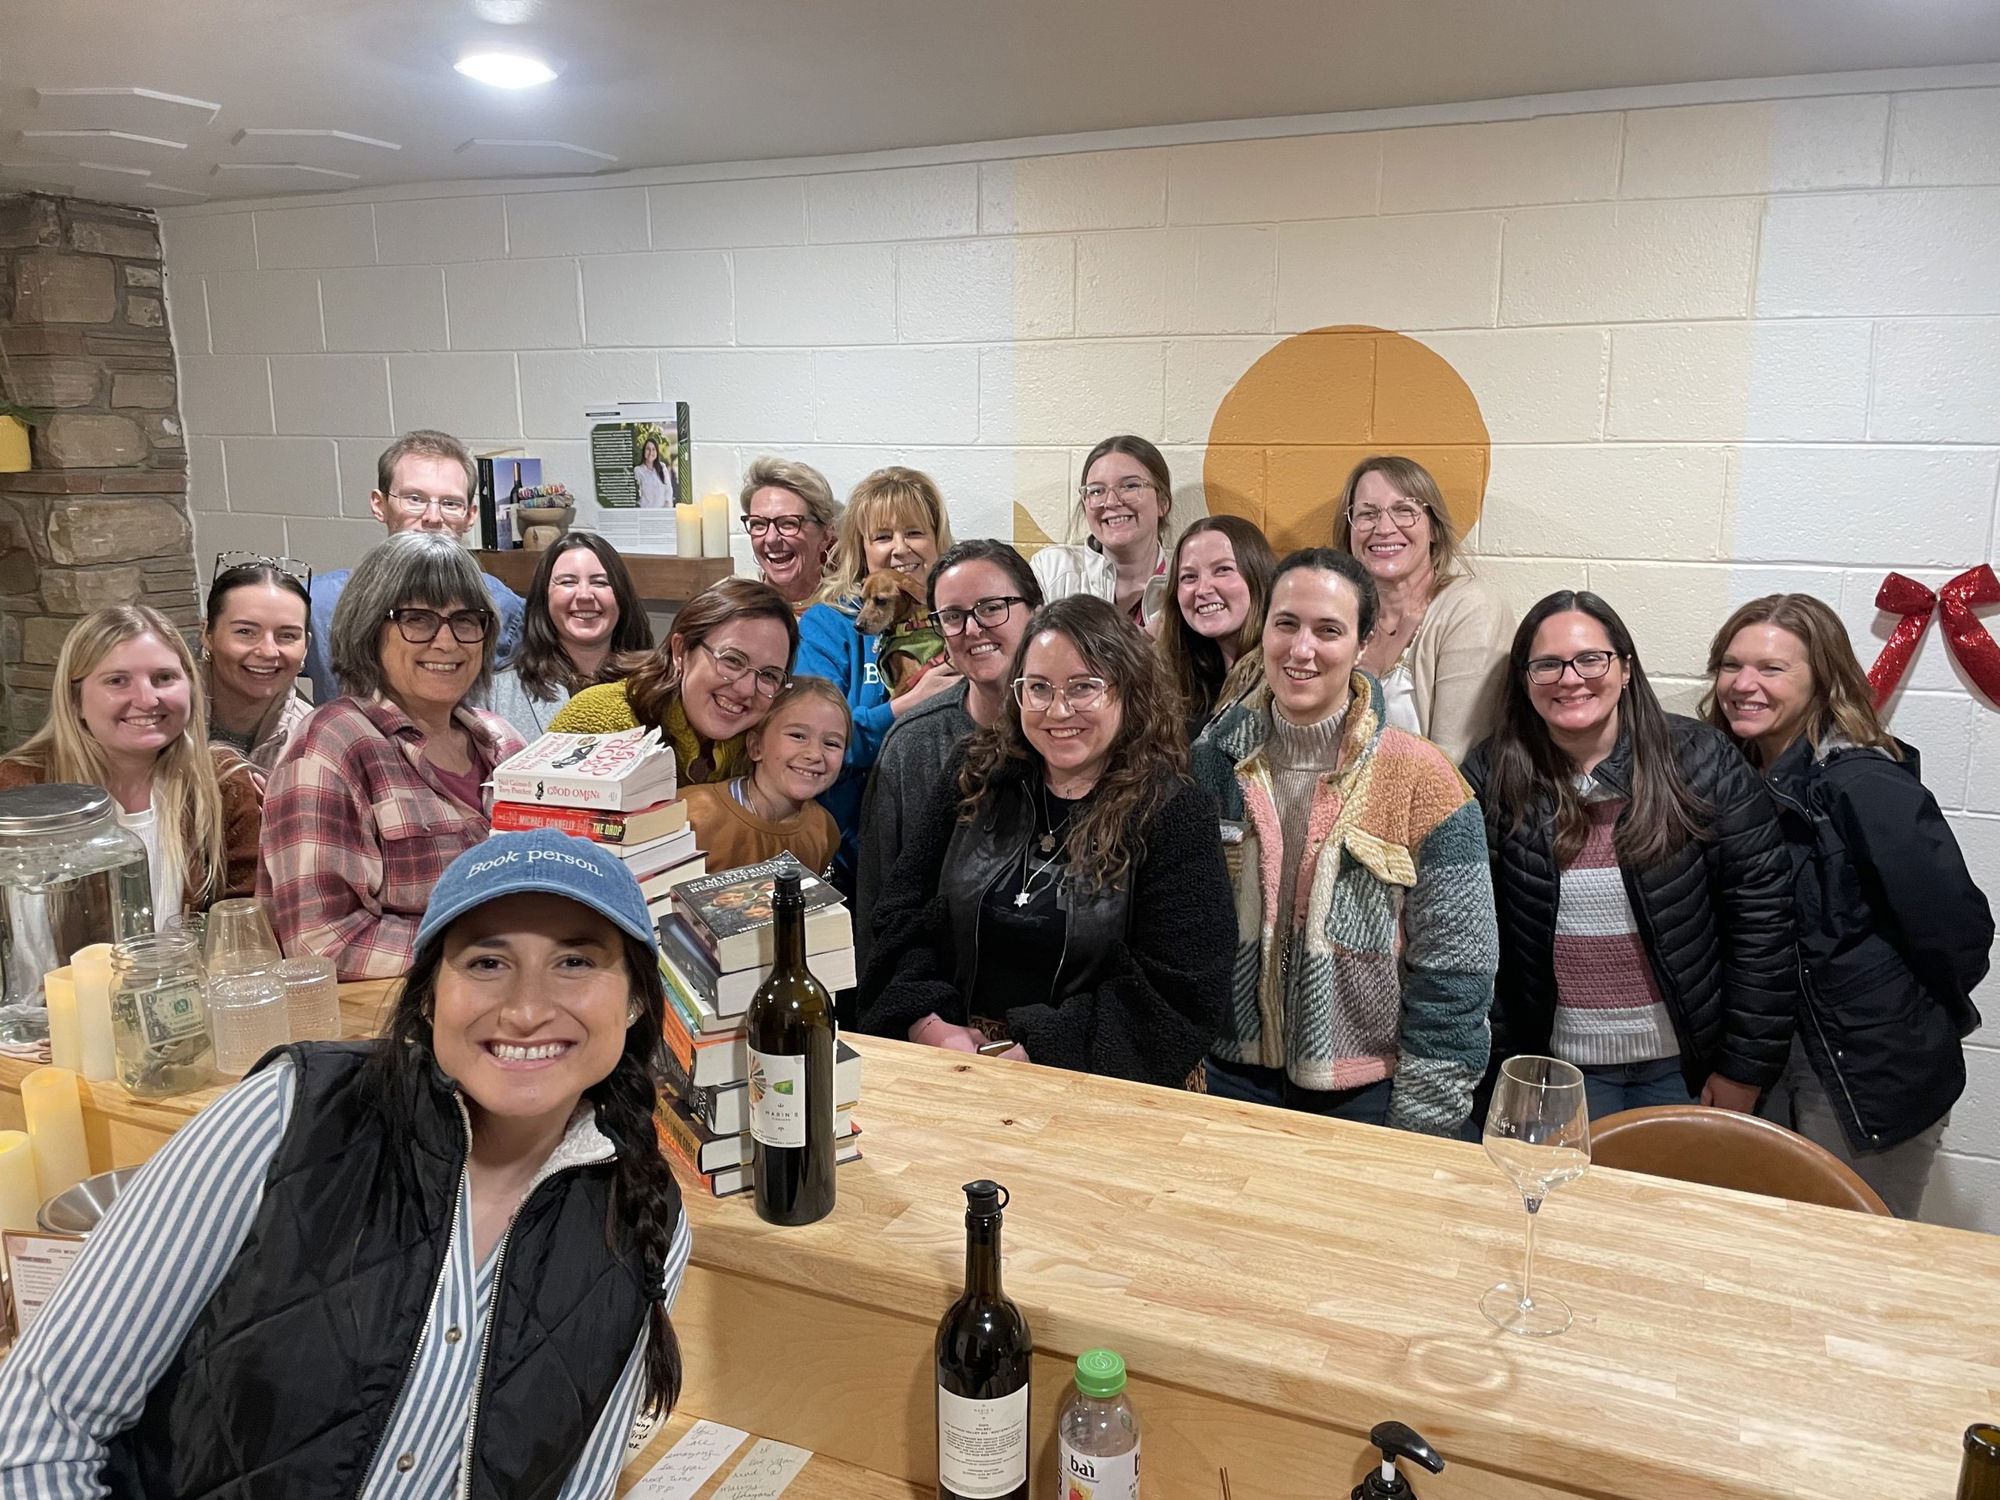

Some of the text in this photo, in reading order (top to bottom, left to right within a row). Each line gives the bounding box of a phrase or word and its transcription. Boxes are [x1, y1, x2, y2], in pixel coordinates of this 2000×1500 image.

[519, 815, 545, 827] MICHAEL
[546, 818, 576, 831] CONNELLY
[593, 823, 604, 834] THE
[604, 824, 623, 836] DROP
[465, 850, 604, 879] Book person.
[1071, 1455, 1095, 1478] bai
